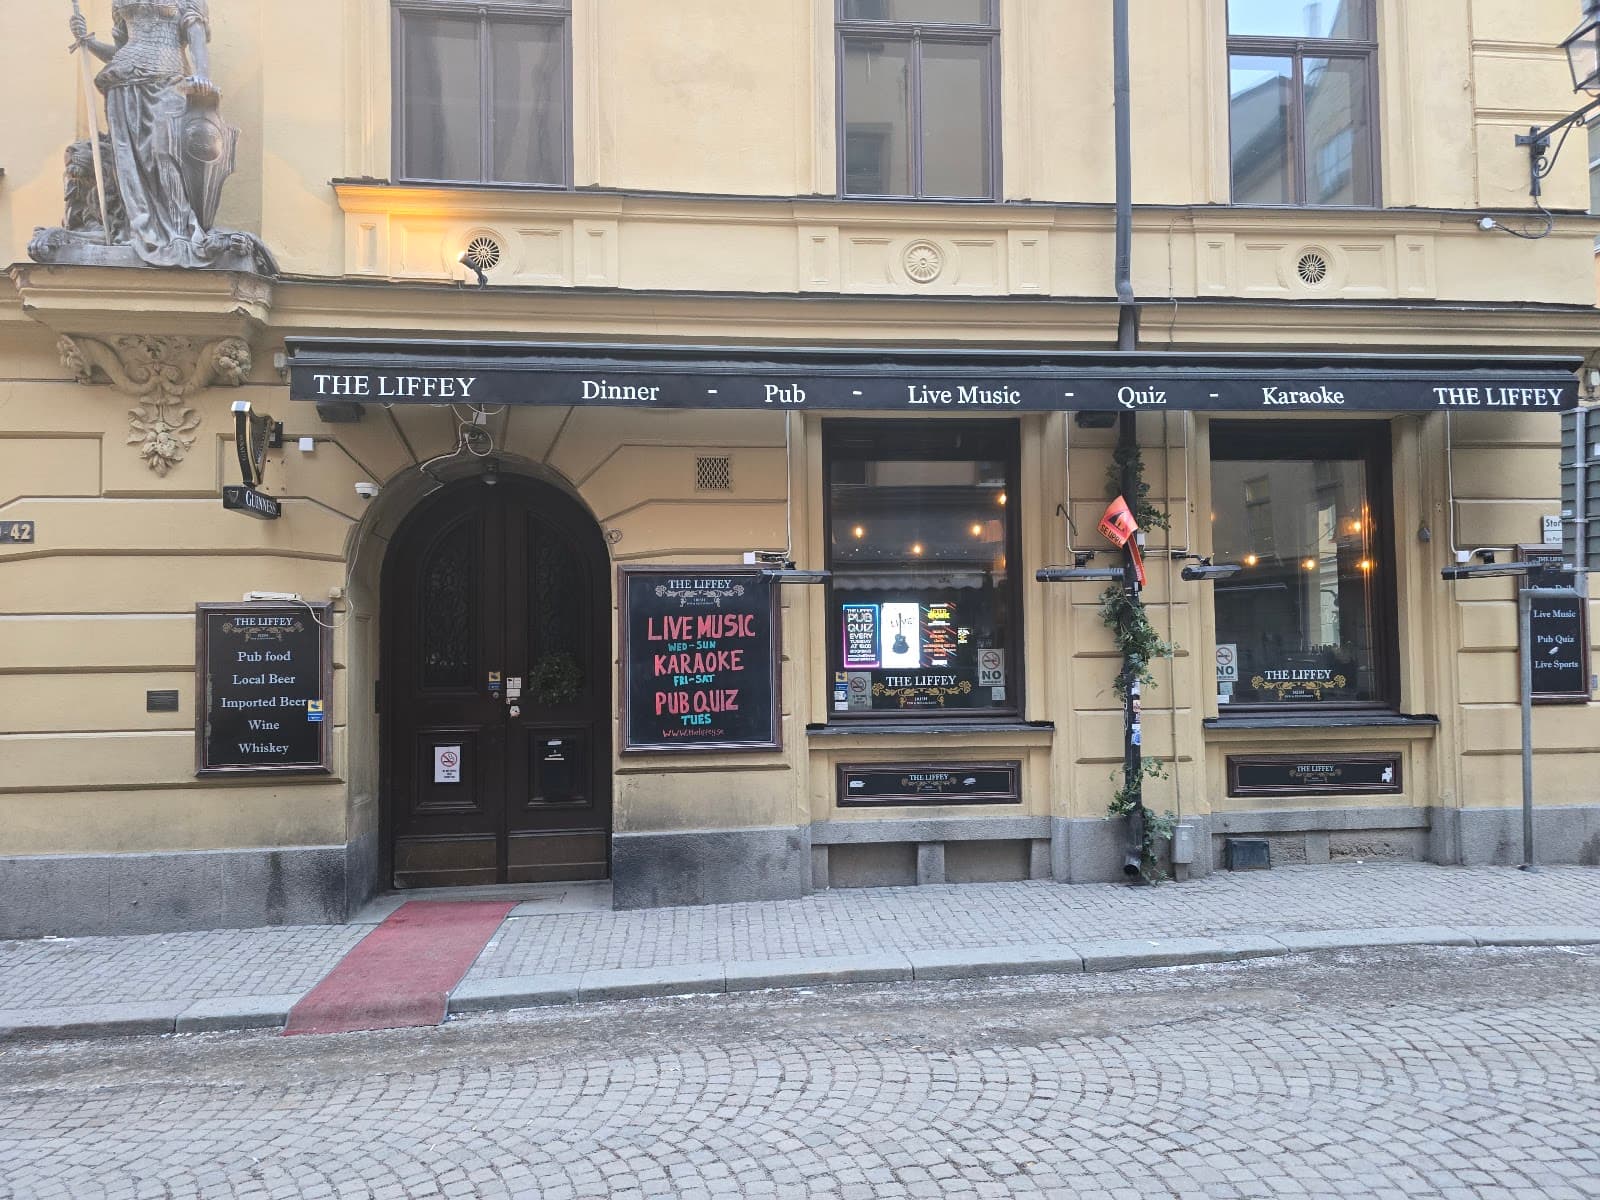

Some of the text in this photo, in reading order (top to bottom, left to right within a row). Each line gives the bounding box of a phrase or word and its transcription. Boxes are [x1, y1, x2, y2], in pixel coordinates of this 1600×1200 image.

[313, 374, 476, 397] THE LIFFEY
[581, 380, 660, 400] Dinner
[764, 384, 806, 404] Pub
[908, 385, 952, 404] Live
[956, 385, 1021, 405] Music
[1117, 386, 1166, 408] Quiz
[1262, 386, 1345, 405] Karaoke
[1433, 388, 1564, 406] THE LIFFEY
[246, 490, 277, 514] GUINNESS
[0, 523, 31, 540] -42
[668, 580, 732, 588] THE LIFFEY
[848, 613, 872, 622] PUB
[1534, 610, 1576, 618] Live Music
[234, 618, 293, 626] THE LIFFEY
[648, 614, 756, 640] LIVE MUSIC
[848, 624, 874, 632] QUIZ
[1537, 634, 1575, 644] Pub Quiz
[238, 650, 292, 662] Pub food
[654, 650, 744, 676] KARAOKE
[1535, 660, 1579, 670] Live Sports
[982, 670, 1002, 680] NO
[1216, 666, 1234, 676] NO
[1264, 669, 1332, 680] THE LIFFEY
[232, 674, 296, 684] Local Beer
[886, 675, 957, 686] THE LIFFEY
[220, 696, 306, 710] Imported Beer
[655, 689, 739, 716] PUB QUIZ
[248, 720, 280, 730] Wine
[680, 714, 712, 726] TUES
[238, 742, 289, 755] Whiskey
